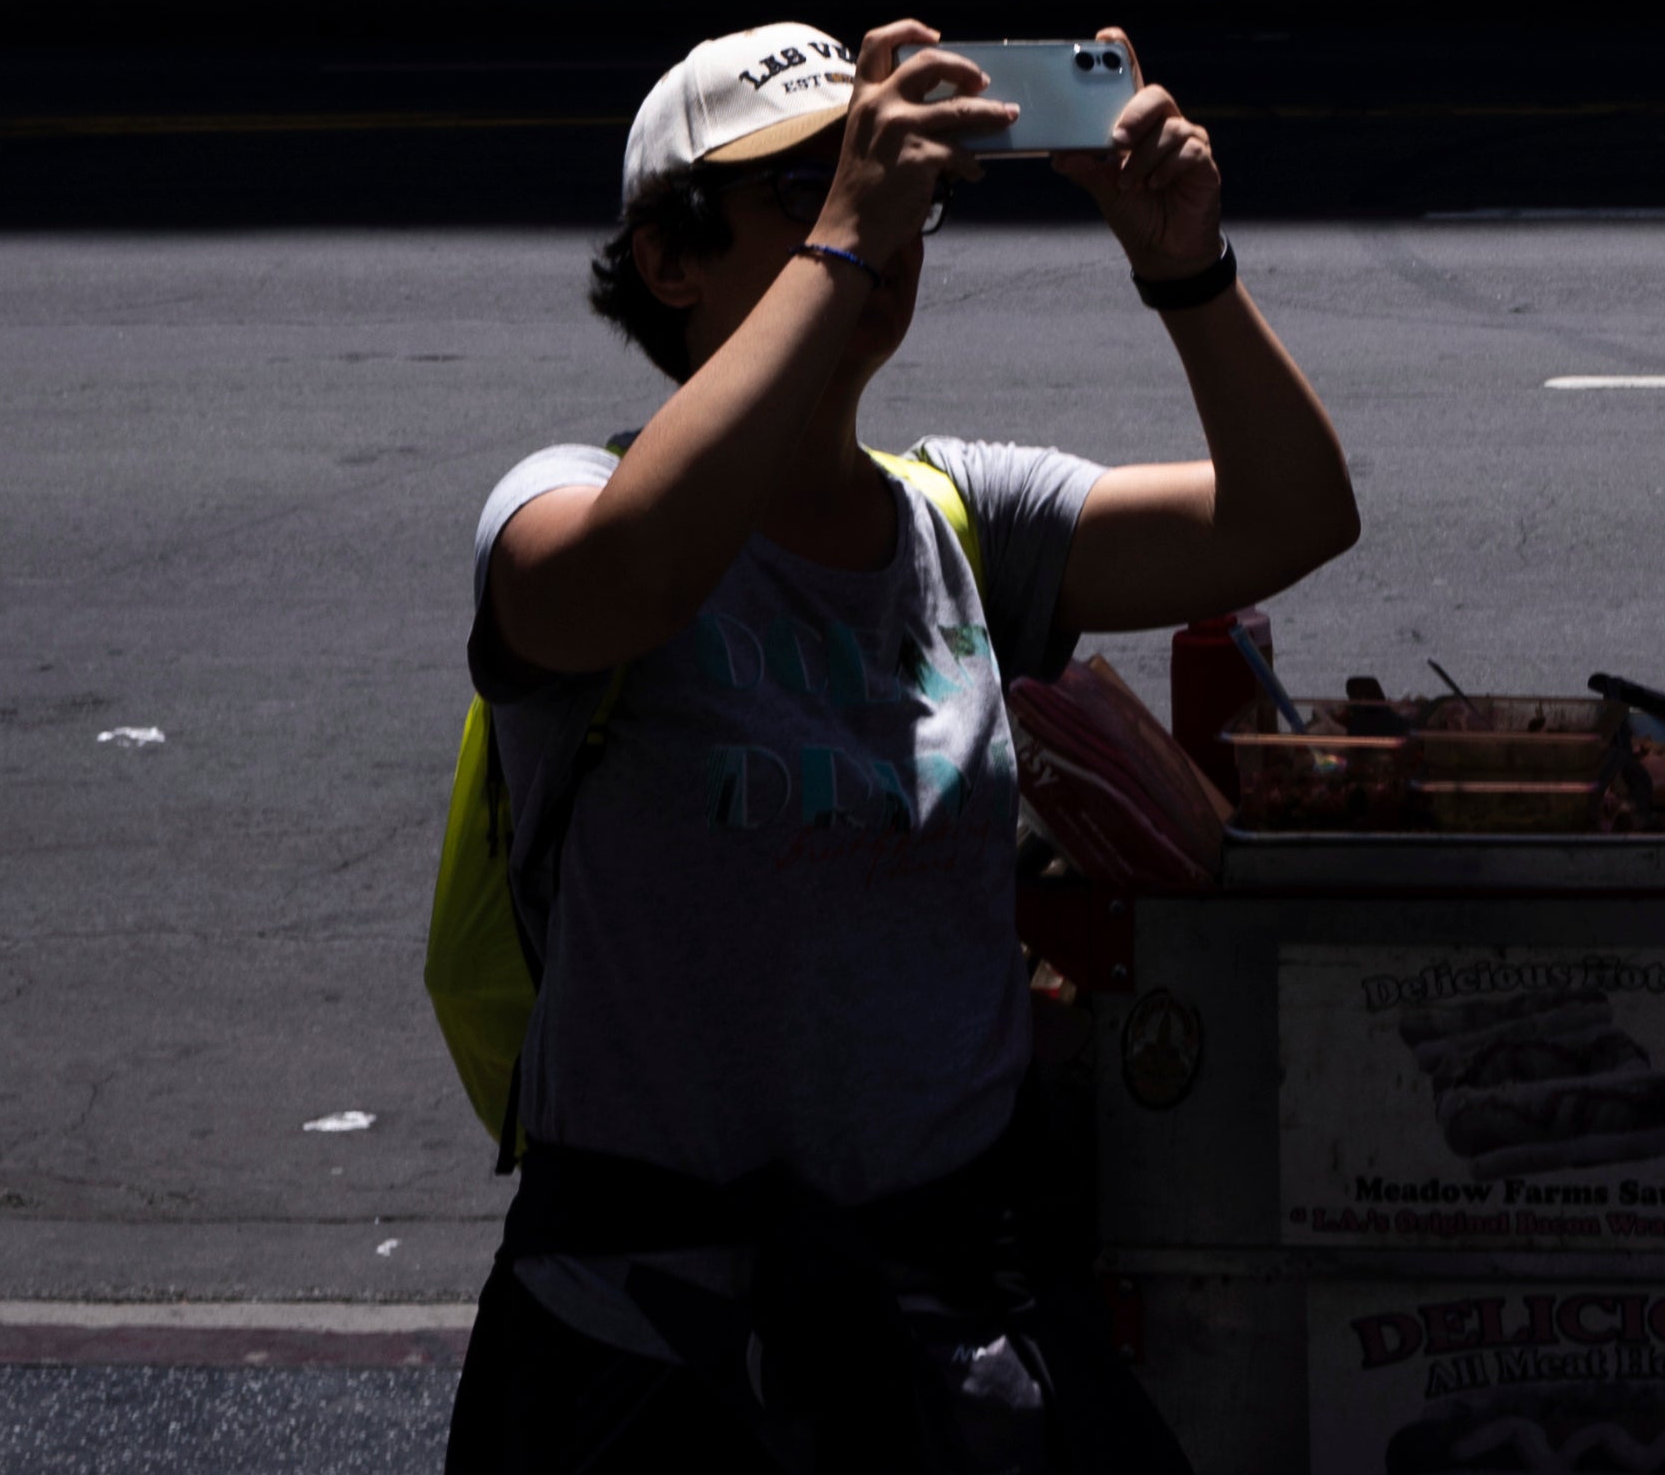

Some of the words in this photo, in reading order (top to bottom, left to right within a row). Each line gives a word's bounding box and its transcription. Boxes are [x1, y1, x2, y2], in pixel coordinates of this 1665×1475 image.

[1362, 961, 1574, 1013] Delicious
[1355, 1177, 1493, 1202] Meadow
[1504, 1178, 1609, 1203] Farms
[1394, 1208, 1510, 1238] Original
[1516, 1210, 1601, 1236] Bacon
[1424, 1350, 1491, 1399] All
[1496, 1348, 1609, 1384] Meat
